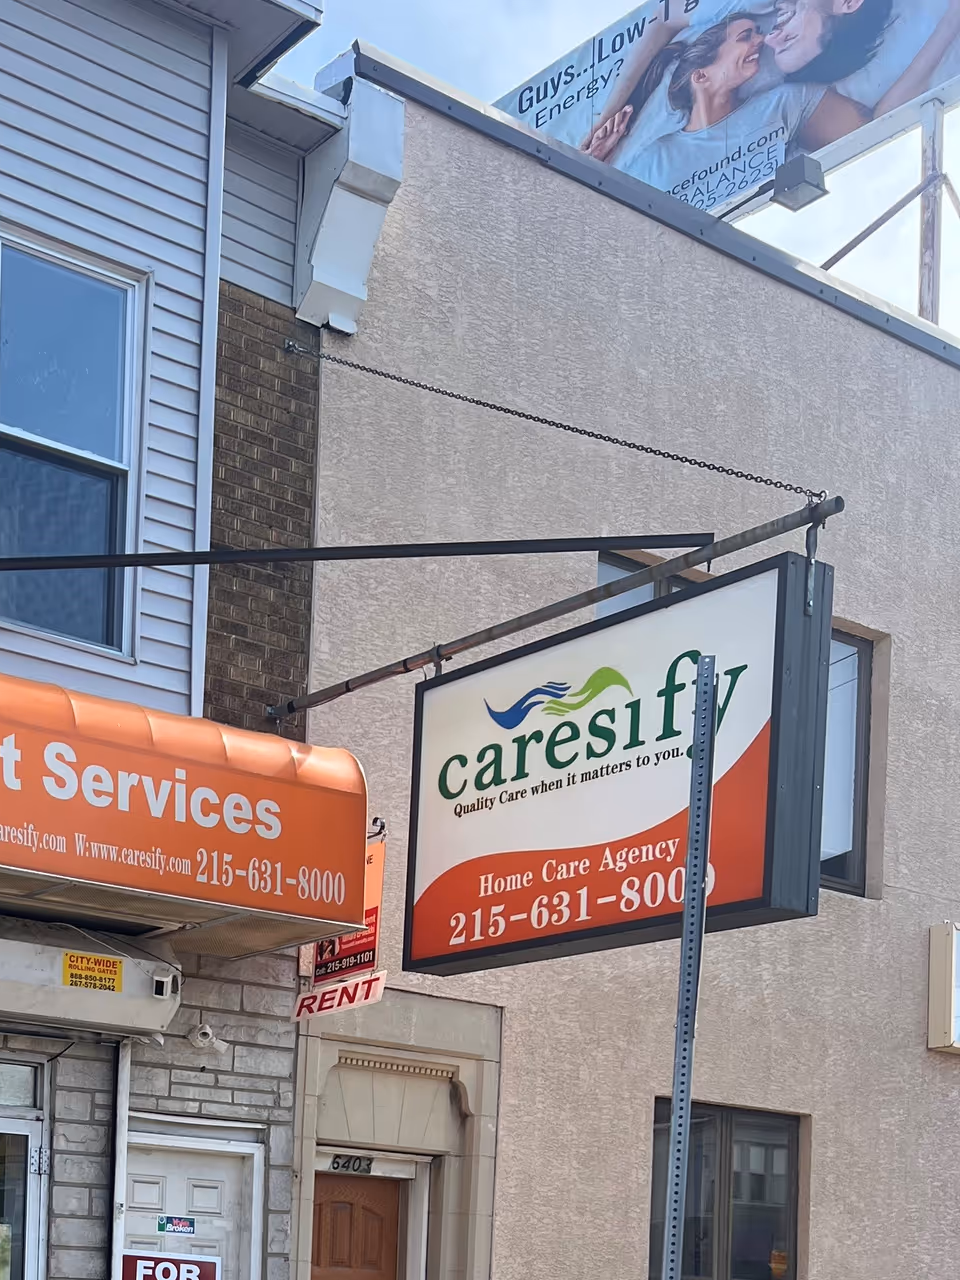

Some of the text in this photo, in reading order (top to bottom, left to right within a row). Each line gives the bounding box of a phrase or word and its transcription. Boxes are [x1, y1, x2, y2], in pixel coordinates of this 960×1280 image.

[535, 58, 625, 129] Energy?
[42, 741, 283, 840] Services
[453, 746, 684, 818] Quality Care when it matters to you.
[196, 848, 346, 905] 215-631-8000
[478, 838, 680, 898] Home Care Agency
[68, 963, 117, 976] ROLLING GATES
[69, 955, 118, 969] CITY-WIDE
[69, 972, 116, 985] 888-850-8177
[326, 950, 373, 973] 215-919-1101
[70, 979, 116, 992] 267-578-2042
[296, 976, 380, 1018] RENT
